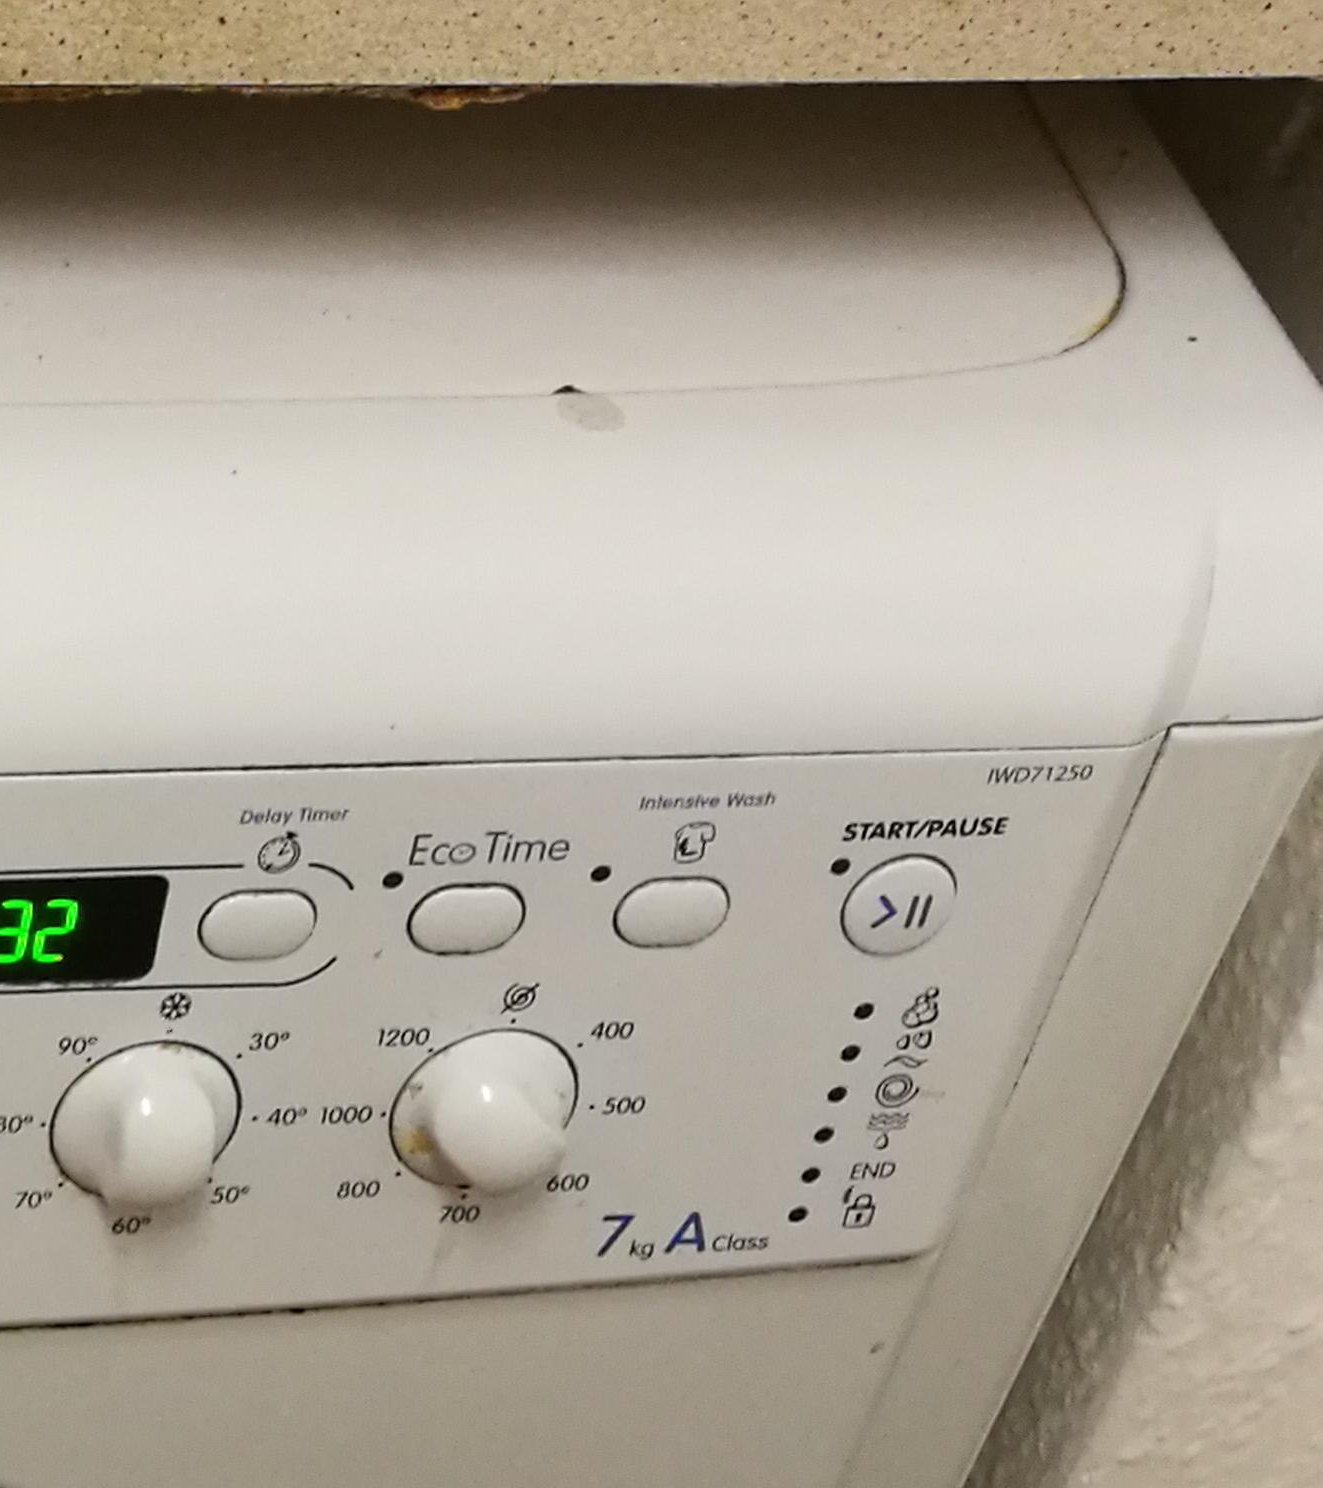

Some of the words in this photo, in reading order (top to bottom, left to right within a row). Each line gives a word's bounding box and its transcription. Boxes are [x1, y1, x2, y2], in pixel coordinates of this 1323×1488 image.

[987, 763, 1094, 784] IWD71250
[638, 794, 721, 811] Intensive
[727, 790, 777, 808] Wash
[239, 809, 293, 828] Delay
[299, 806, 350, 823] Timer
[843, 816, 1009, 842] START/PAUSE
[484, 831, 571, 864] Time
[377, 1027, 431, 1048] 1200
[590, 1020, 635, 1041] 400
[319, 1104, 373, 1126] 1000
[601, 1096, 646, 1117] 500
[847, 1160, 897, 1181] END
[336, 1179, 381, 1199] 800
[546, 1171, 590, 1193] 600
[438, 1203, 481, 1225] 700
[627, 1237, 656, 1260] kg
[665, 1212, 708, 1253] A
[711, 1232, 770, 1253] Class
